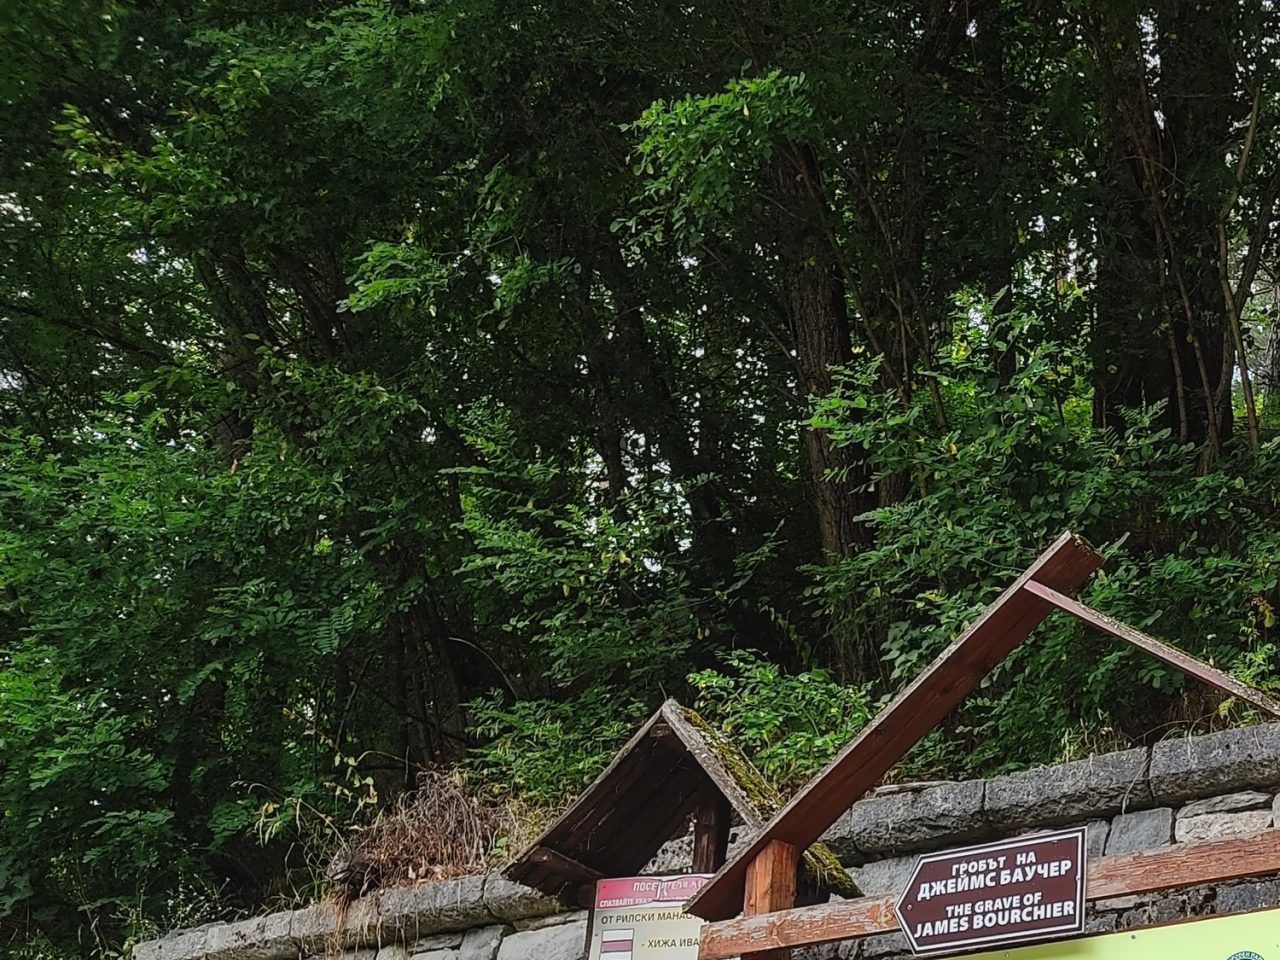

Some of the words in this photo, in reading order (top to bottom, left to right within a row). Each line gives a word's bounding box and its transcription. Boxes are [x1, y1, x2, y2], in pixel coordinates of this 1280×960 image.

[952, 856, 1006, 876] ГРОБЪТ
[1016, 851, 1036, 866] НА
[917, 873, 996, 901] ДЖЕЙМС
[1000, 860, 1072, 886] БАУЧЕР
[946, 903, 972, 918] THE
[974, 895, 1021, 913] GRAVE
[1023, 892, 1042, 906] OF
[601, 916, 613, 925] ОТ
[616, 913, 654, 923] РИЛСКИ
[657, 911, 697, 921] МАНАС
[914, 920, 969, 939] JAMES
[973, 900, 1074, 930] BOURCHIER
[648, 939, 677, 948] ХИЖА
